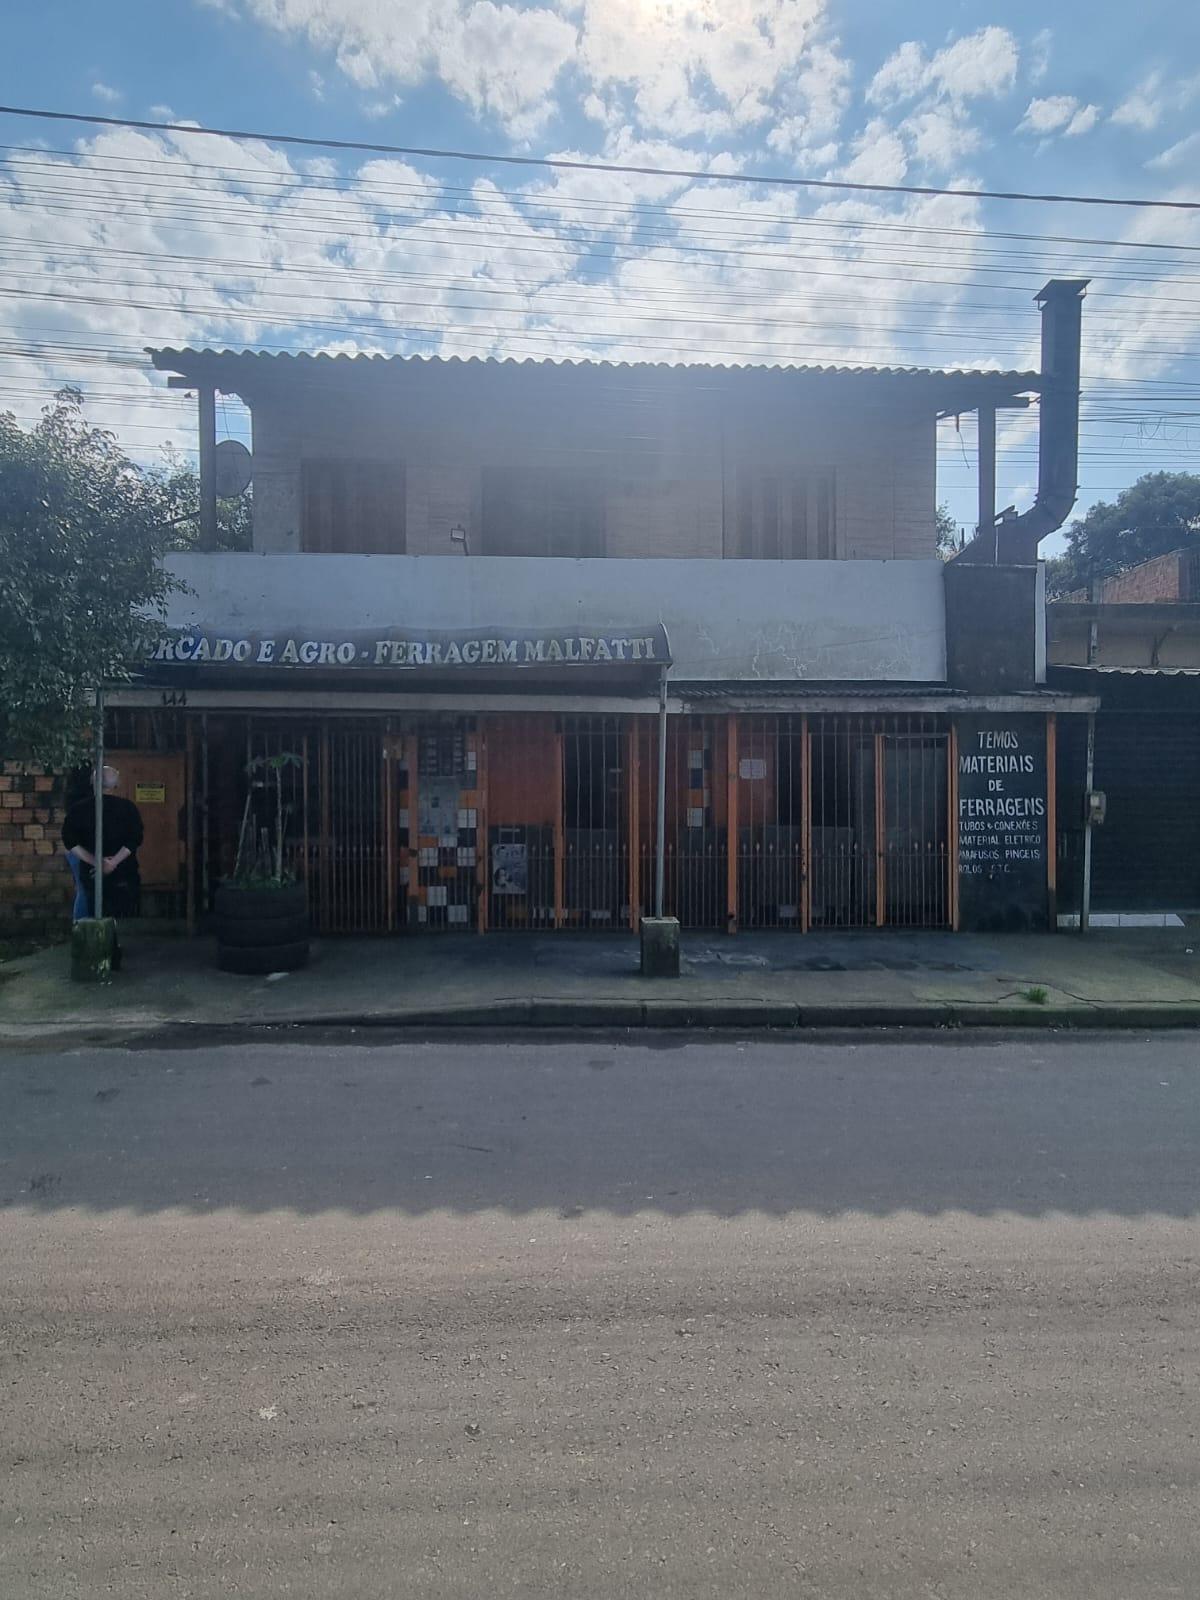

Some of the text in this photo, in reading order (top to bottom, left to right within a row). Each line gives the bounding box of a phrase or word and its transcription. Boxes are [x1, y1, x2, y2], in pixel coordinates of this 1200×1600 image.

[256, 640, 276, 662] E
[279, 639, 356, 664] AGRO
[374, 639, 518, 665] FERRAGEM
[523, 637, 656, 663] MALFATTI
[977, 730, 1019, 749] TEMOS
[959, 754, 1034, 773] MATERIAIS
[988, 779, 1004, 792] DE
[959, 797, 1045, 817] FERRAGENS
[959, 821, 985, 831] TUBOS
[959, 835, 1000, 846] MATERIAL
